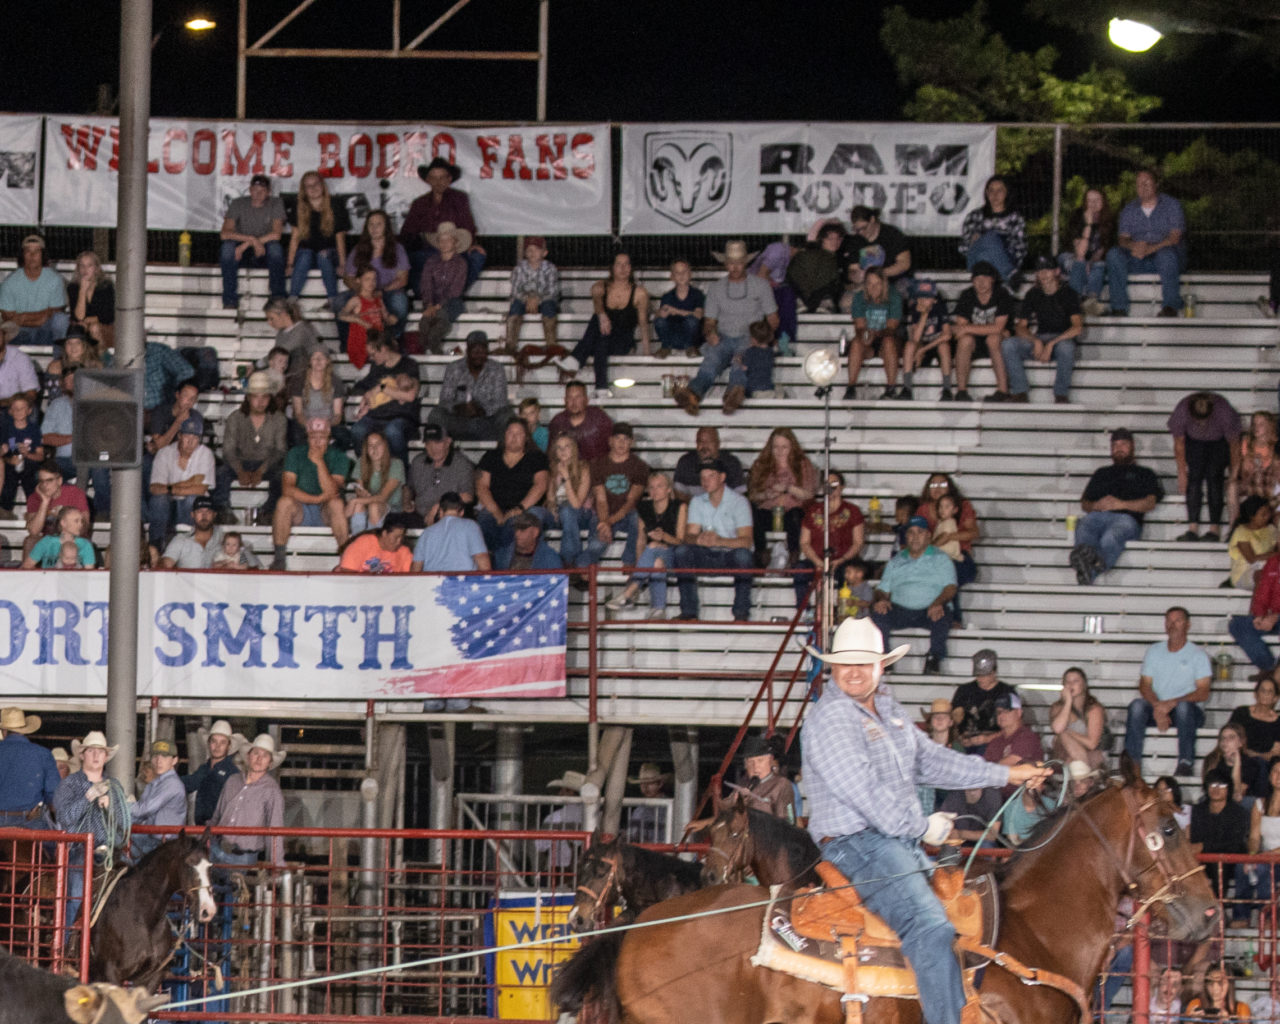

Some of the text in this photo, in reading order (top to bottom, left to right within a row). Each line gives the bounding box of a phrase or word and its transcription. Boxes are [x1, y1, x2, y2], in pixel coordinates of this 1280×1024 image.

[318, 131, 457, 179] RODEO
[478, 132, 596, 181] FANS
[759, 143, 970, 176] RAM
[758, 180, 971, 216] RODEO
[154, 601, 416, 671] SMITH
